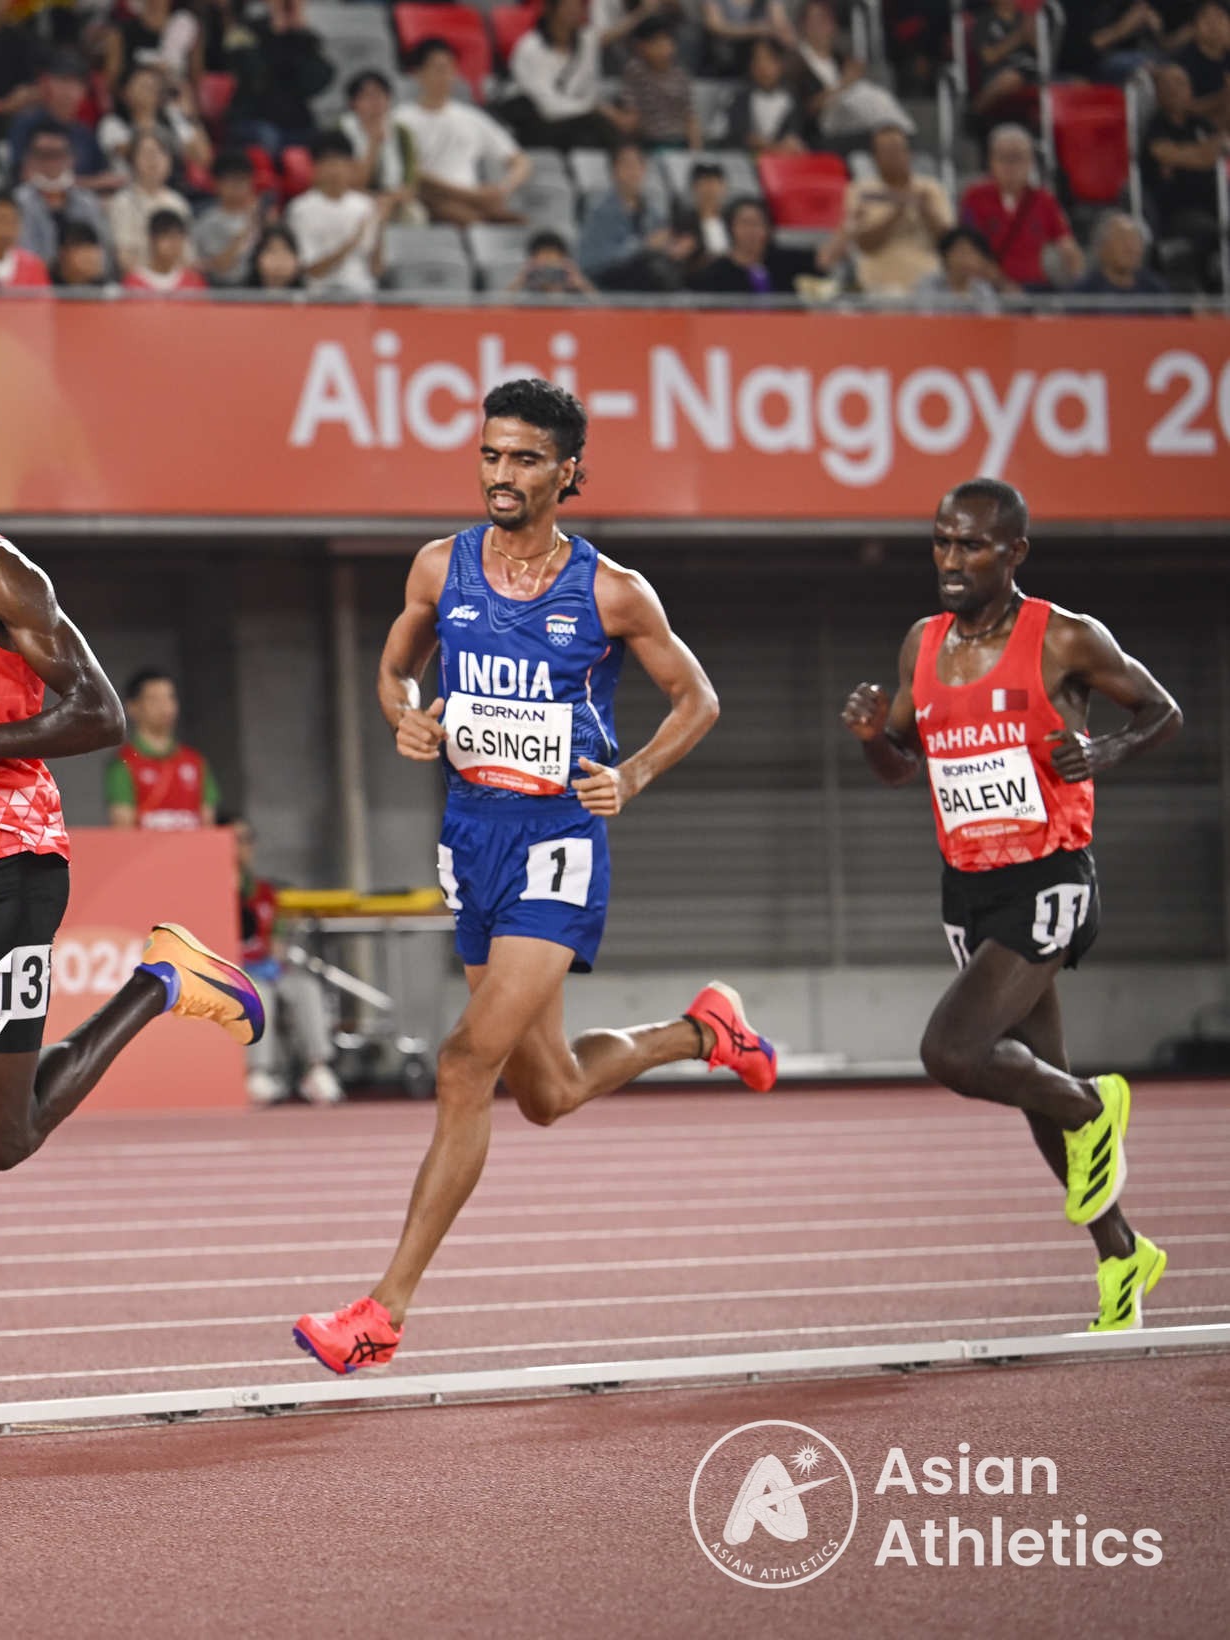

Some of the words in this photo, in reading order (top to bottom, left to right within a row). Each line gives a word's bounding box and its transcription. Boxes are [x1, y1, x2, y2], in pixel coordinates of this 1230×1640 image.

[1145, 348, 1230, 456] 2
[546, 622, 577, 635] INDIA
[459, 651, 555, 701] INDIA
[471, 703, 545, 721] BORNAN
[456, 726, 561, 762] G.SINGH
[926, 722, 1026, 754] BAHRAIN
[539, 765, 561, 775] 322
[942, 757, 1005, 777] BORNAN
[938, 777, 1026, 813] BALEW
[551, 847, 566, 892] 1
[1044, 893, 1082, 937] 11
[1, 955, 43, 1010] 13
